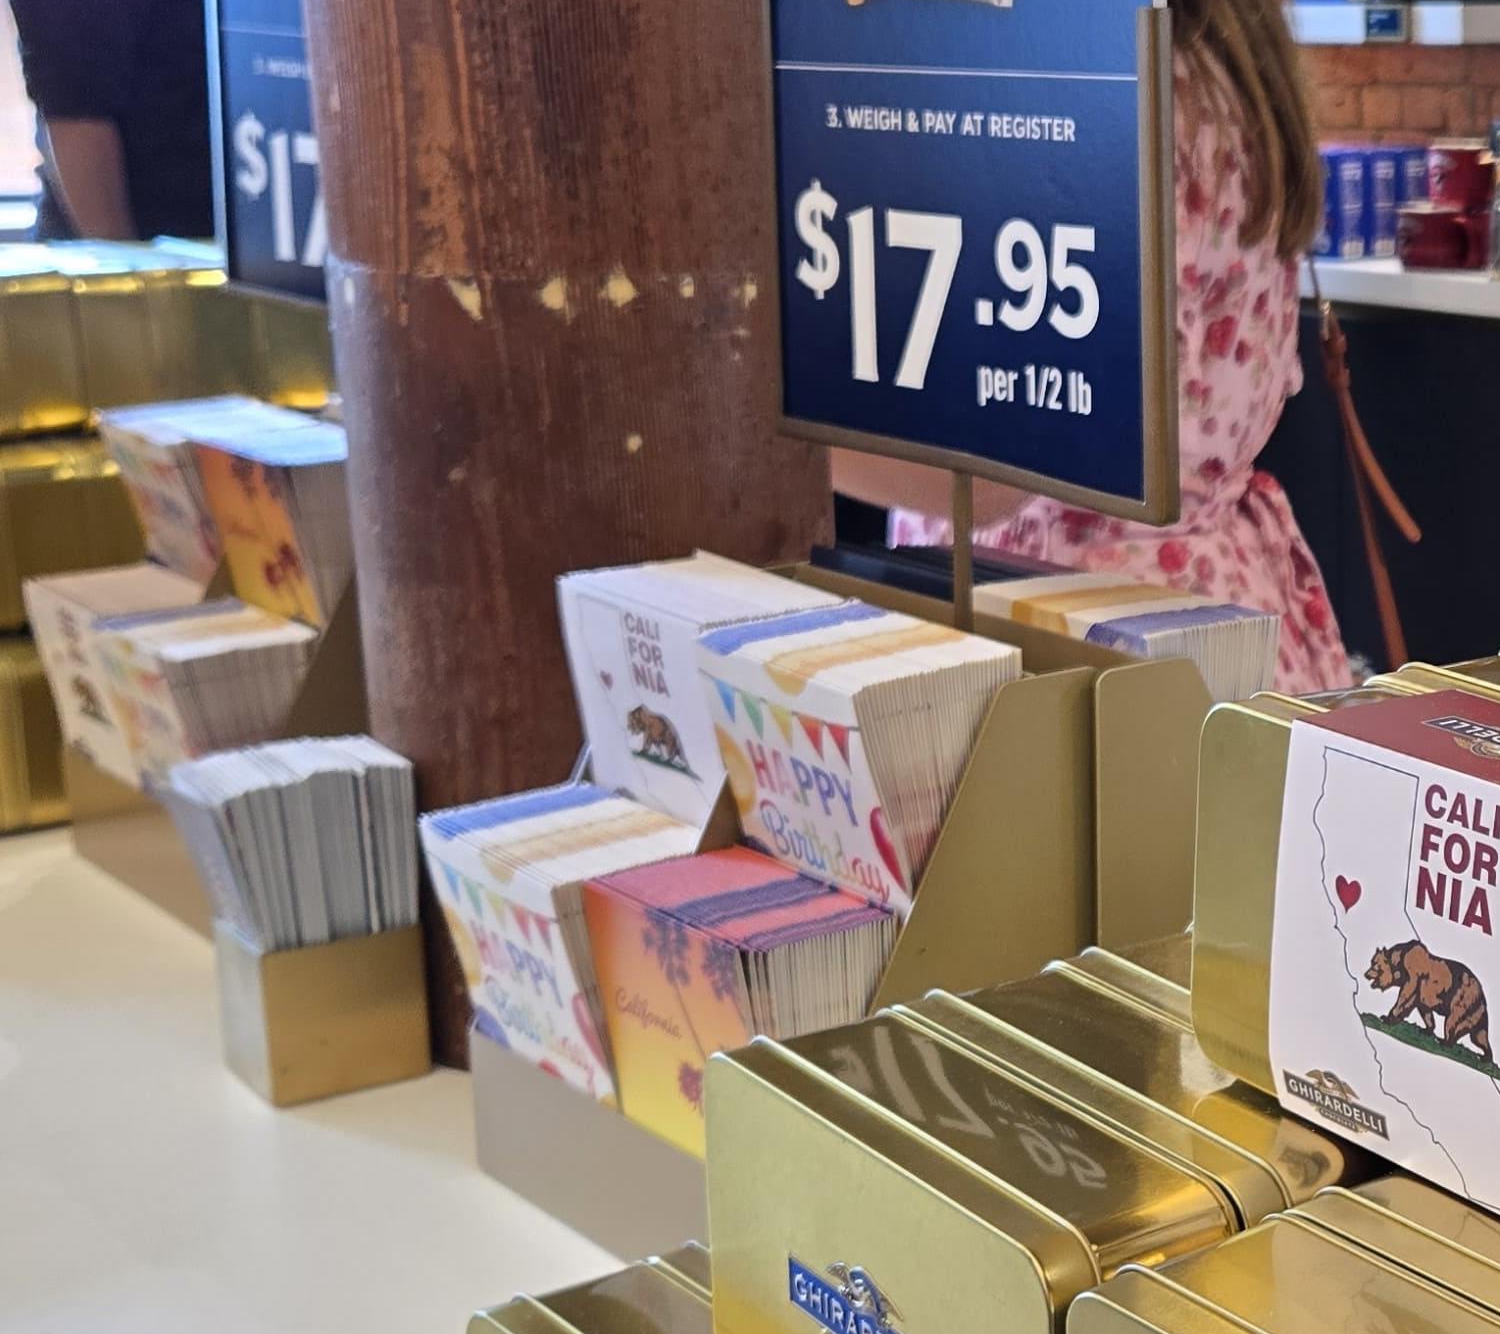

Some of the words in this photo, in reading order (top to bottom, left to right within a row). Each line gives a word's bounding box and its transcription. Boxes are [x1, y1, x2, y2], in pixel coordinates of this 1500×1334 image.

[825, 104, 842, 128] 3.
[843, 106, 902, 131] WEIGH
[907, 113, 920, 134] &
[922, 111, 956, 136] PAY
[960, 114, 985, 137] AT
[988, 114, 1076, 143] REGISTER
[795, 178, 1099, 390] $17.95
[976, 365, 1019, 407] per
[1024, 363, 1063, 411] 1/2
[1067, 369, 1092, 416] lb
[623, 611, 661, 643] CALI
[627, 635, 665, 671] FOR
[631, 660, 672, 699] NIA
[746, 739, 858, 827] HAPPY
[1419, 823, 1499, 887] FOR
[1414, 866, 1494, 936] NIA
[1288, 1077, 1382, 1133] GHIRARDELLI
